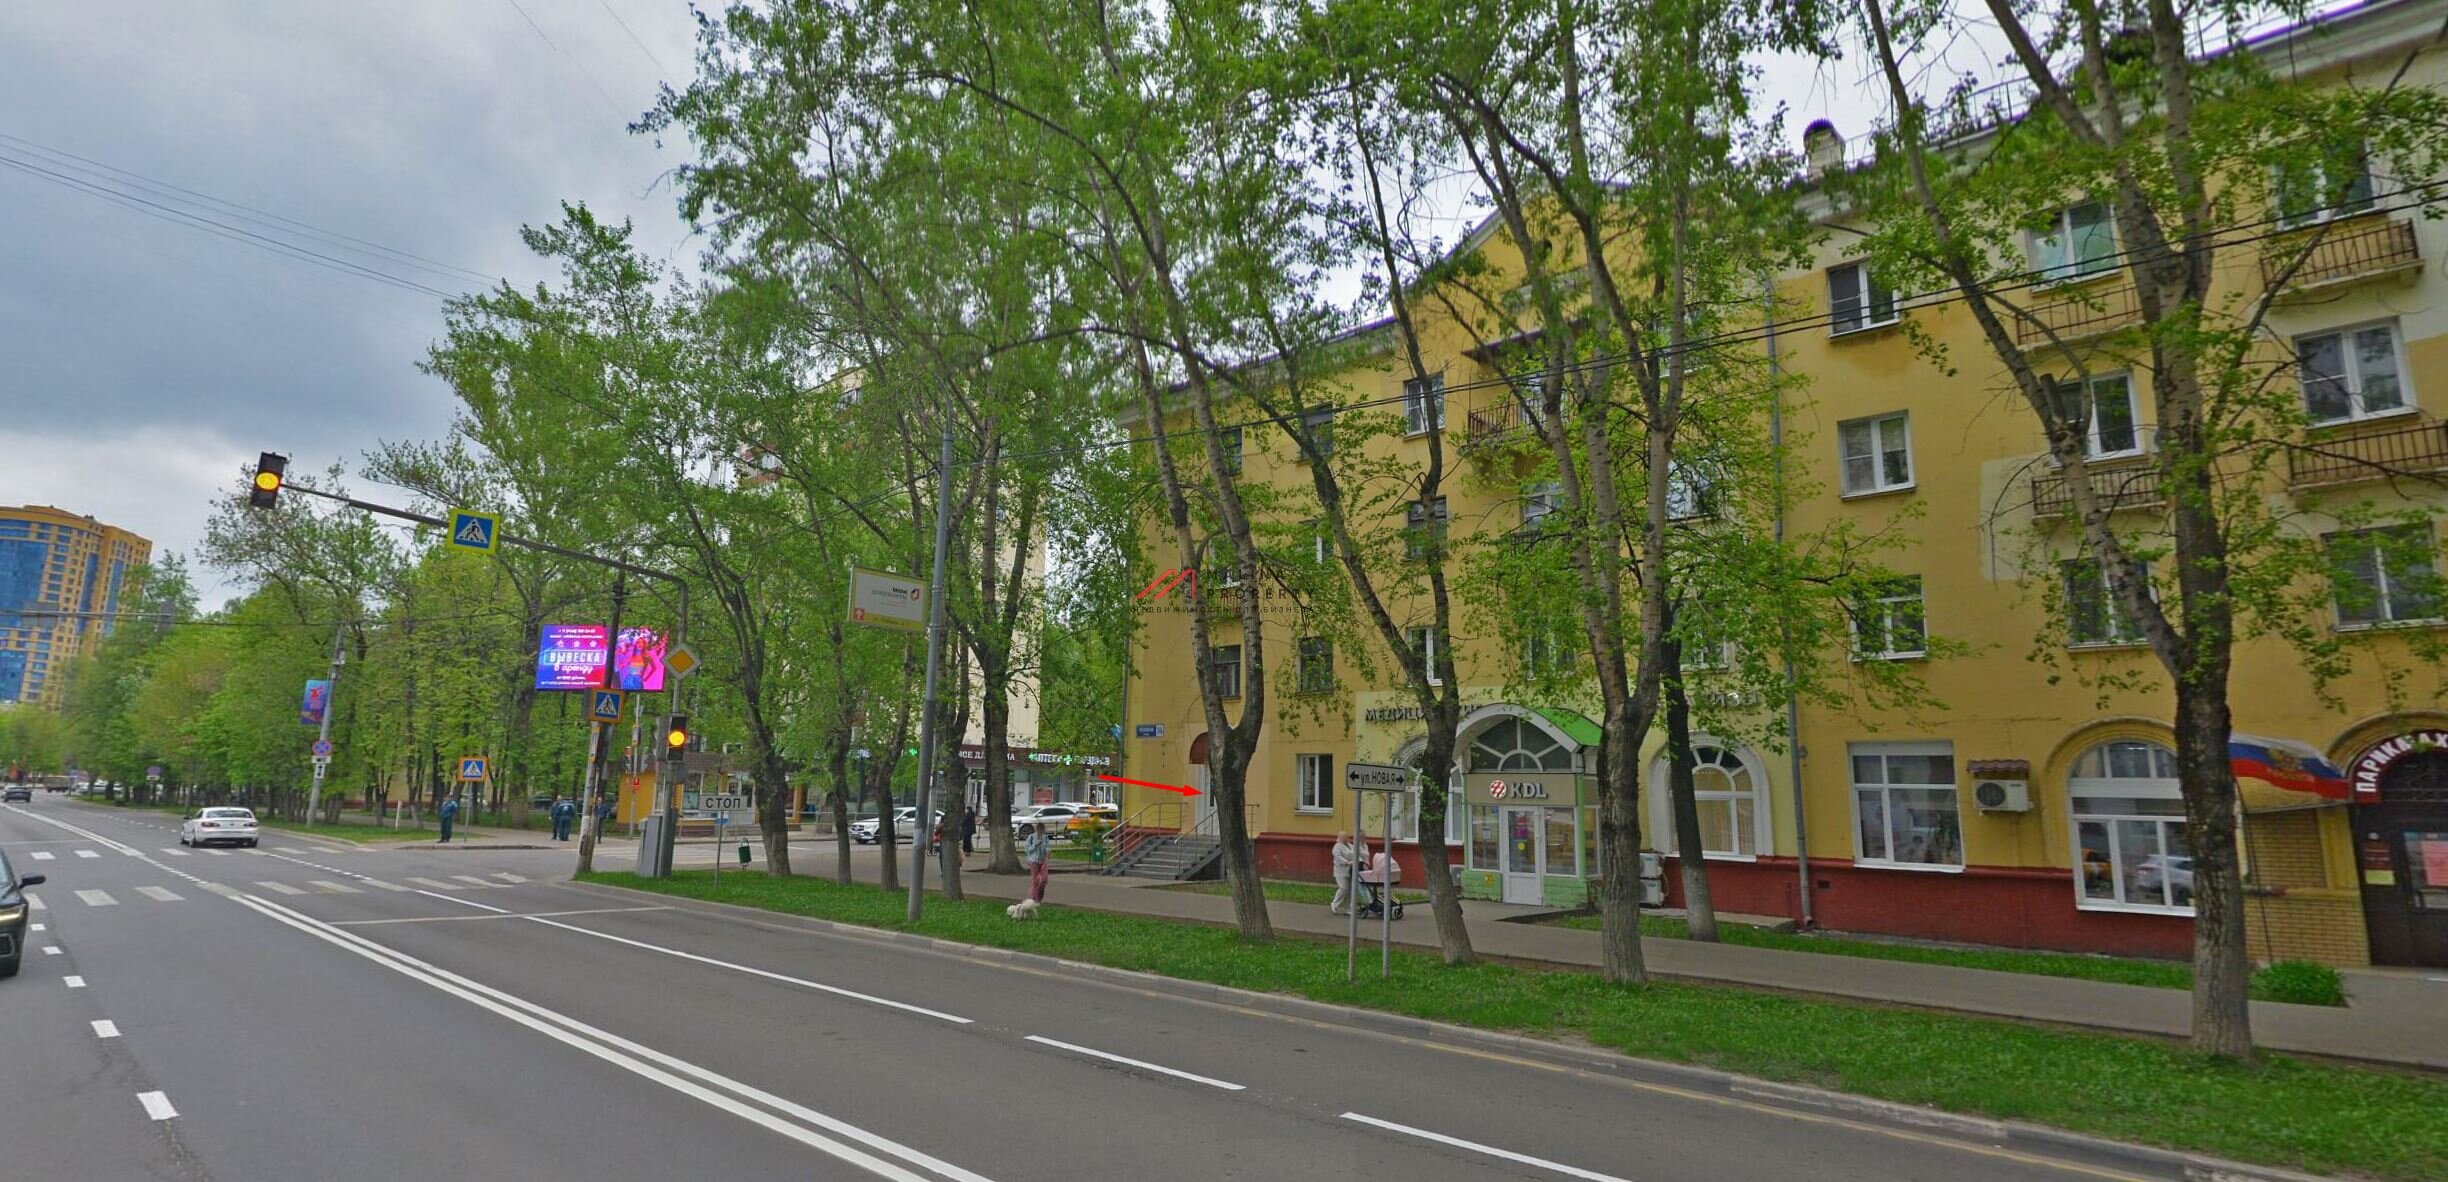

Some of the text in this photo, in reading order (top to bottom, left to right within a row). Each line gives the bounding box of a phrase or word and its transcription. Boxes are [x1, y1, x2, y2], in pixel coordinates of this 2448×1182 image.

[549, 652, 601, 663] ВЫВЕСКА
[1510, 782, 1548, 799] KDL
[705, 797, 741, 809] СТОП
